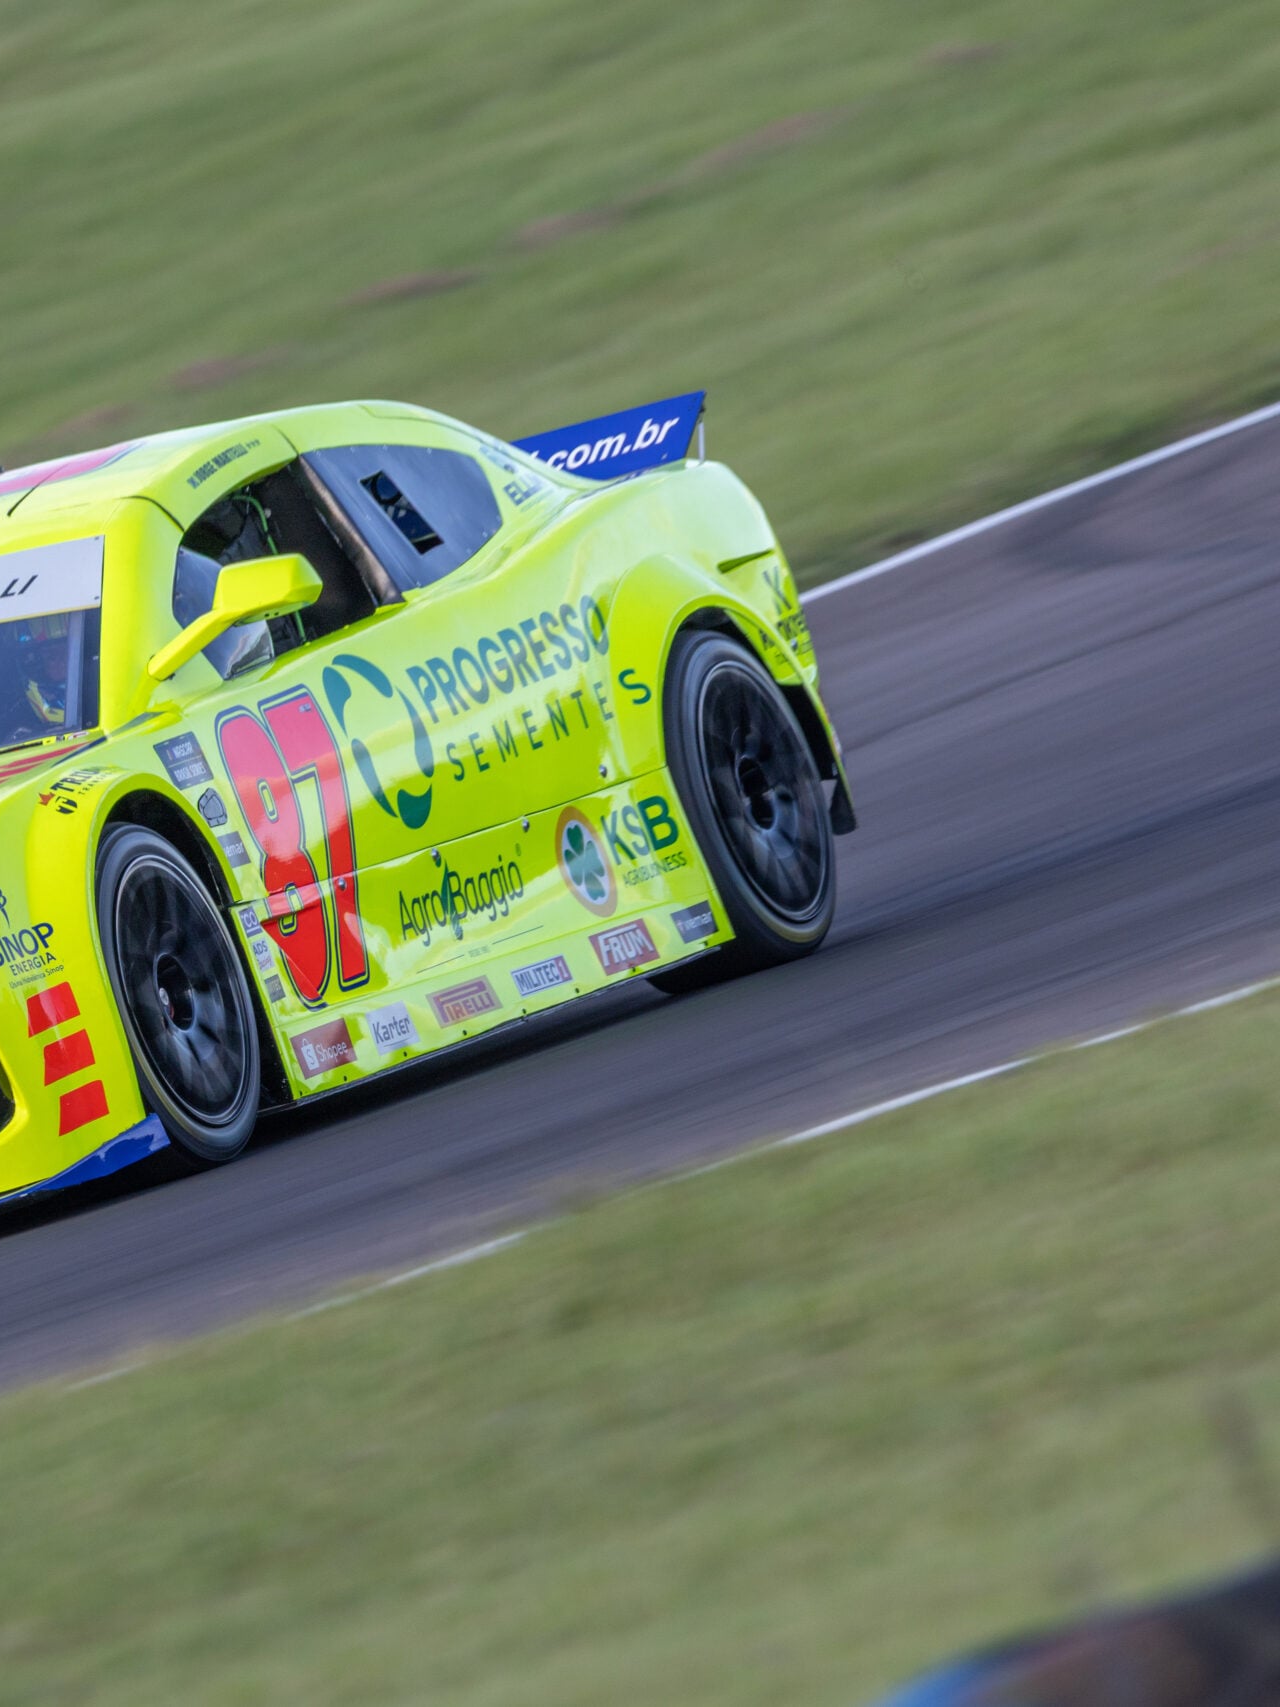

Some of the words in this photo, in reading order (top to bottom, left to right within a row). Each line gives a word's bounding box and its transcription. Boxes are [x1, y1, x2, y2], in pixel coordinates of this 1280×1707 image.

[405, 594, 610, 725] PROGRESSO
[445, 668, 652, 782] SEMENTES
[214, 682, 371, 1011] 87
[600, 795, 679, 866] KSB
[9, 951, 57, 977] ENERGIA
[597, 923, 654, 968] FRUM
[514, 961, 561, 994] MILITEC
[558, 956, 570, 980] 1
[432, 980, 496, 1023] PIRELLI
[372, 1015, 411, 1045] Karter
[316, 1041, 349, 1065] Shopee
